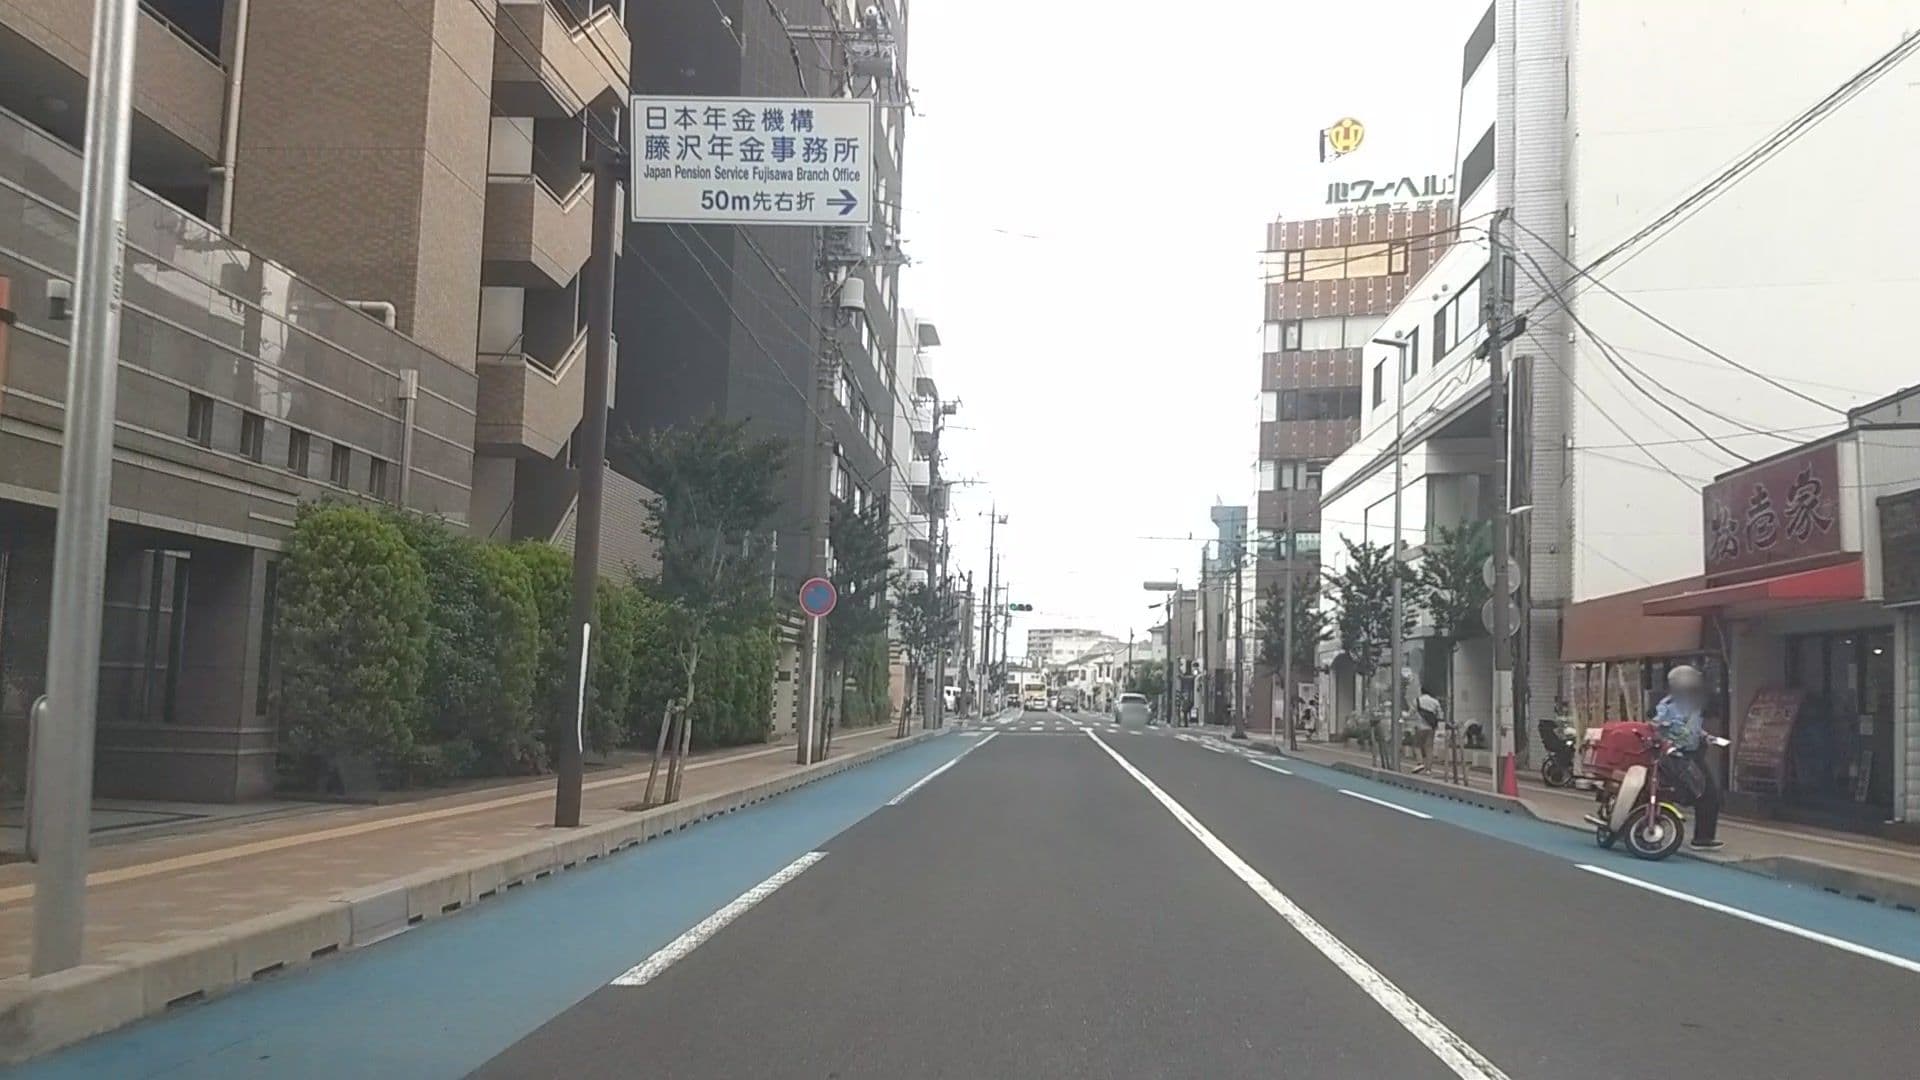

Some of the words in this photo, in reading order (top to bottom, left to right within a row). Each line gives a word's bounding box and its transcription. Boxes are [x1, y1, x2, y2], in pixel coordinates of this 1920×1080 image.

[646, 106, 814, 132] 日本年金機構
[645, 134, 859, 163] 藤沢年金事務所
[644, 165, 671, 180] Japan
[675, 165, 711, 179] Pension
[715, 165, 749, 180] Service
[753, 166, 793, 183] Fujisawa
[797, 167, 829, 181] Branch
[833, 167, 860, 181] Office
[701, 190, 815, 212] 50m先右折
